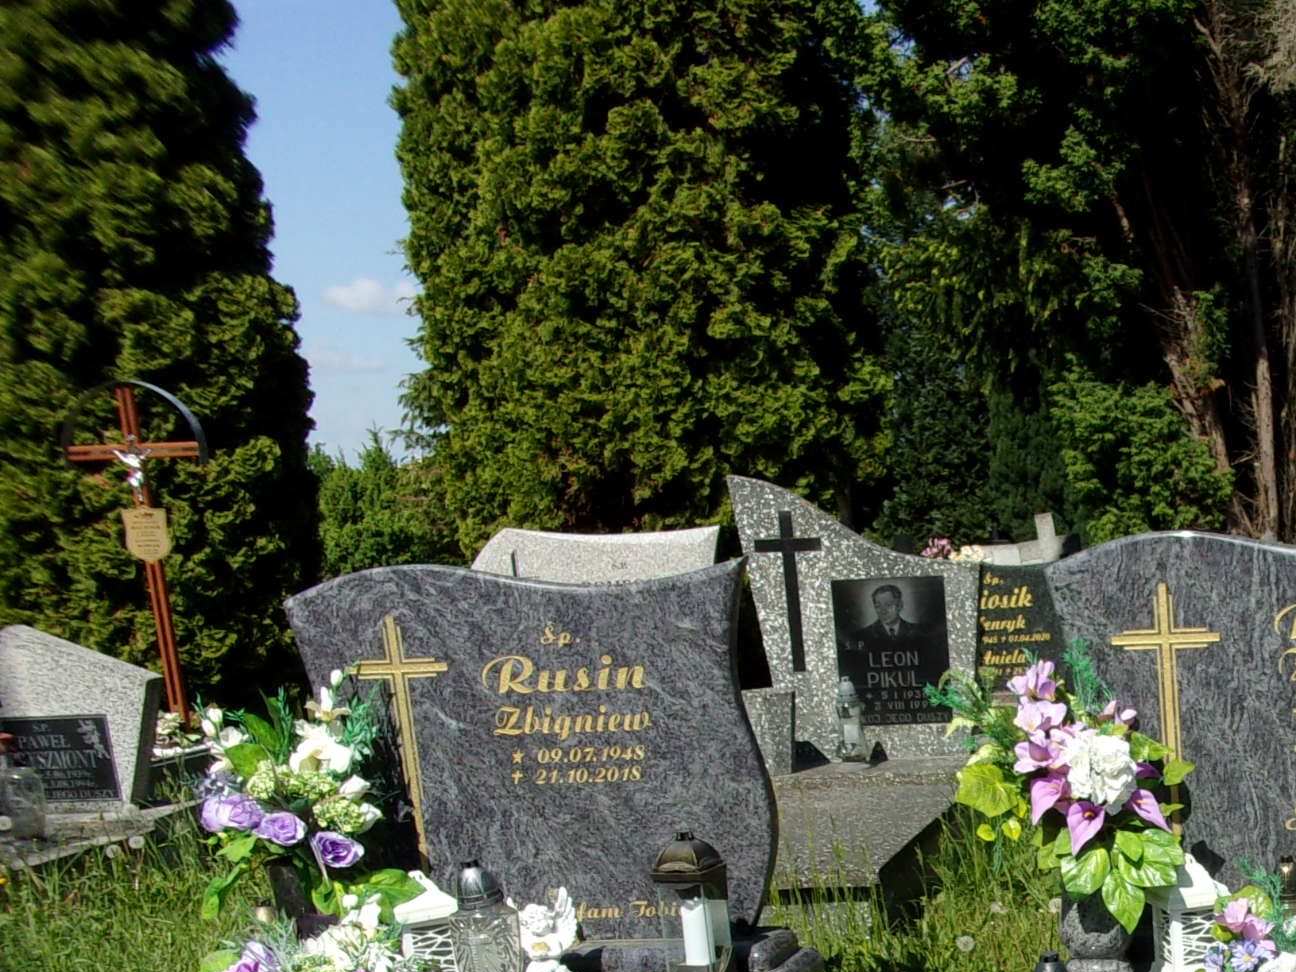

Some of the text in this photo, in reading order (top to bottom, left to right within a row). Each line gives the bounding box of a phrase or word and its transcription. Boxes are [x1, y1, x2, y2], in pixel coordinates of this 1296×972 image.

[980, 585, 1034, 610] iosik
[869, 650, 920, 668] LEON
[482, 655, 648, 694] Rusin
[867, 670, 923, 689] PIKUL
[493, 704, 652, 741] Zbigniew
[537, 745, 646, 764] 09.07.1948
[535, 765, 642, 785] 21.10.2018
[576, 901, 621, 922] fam
